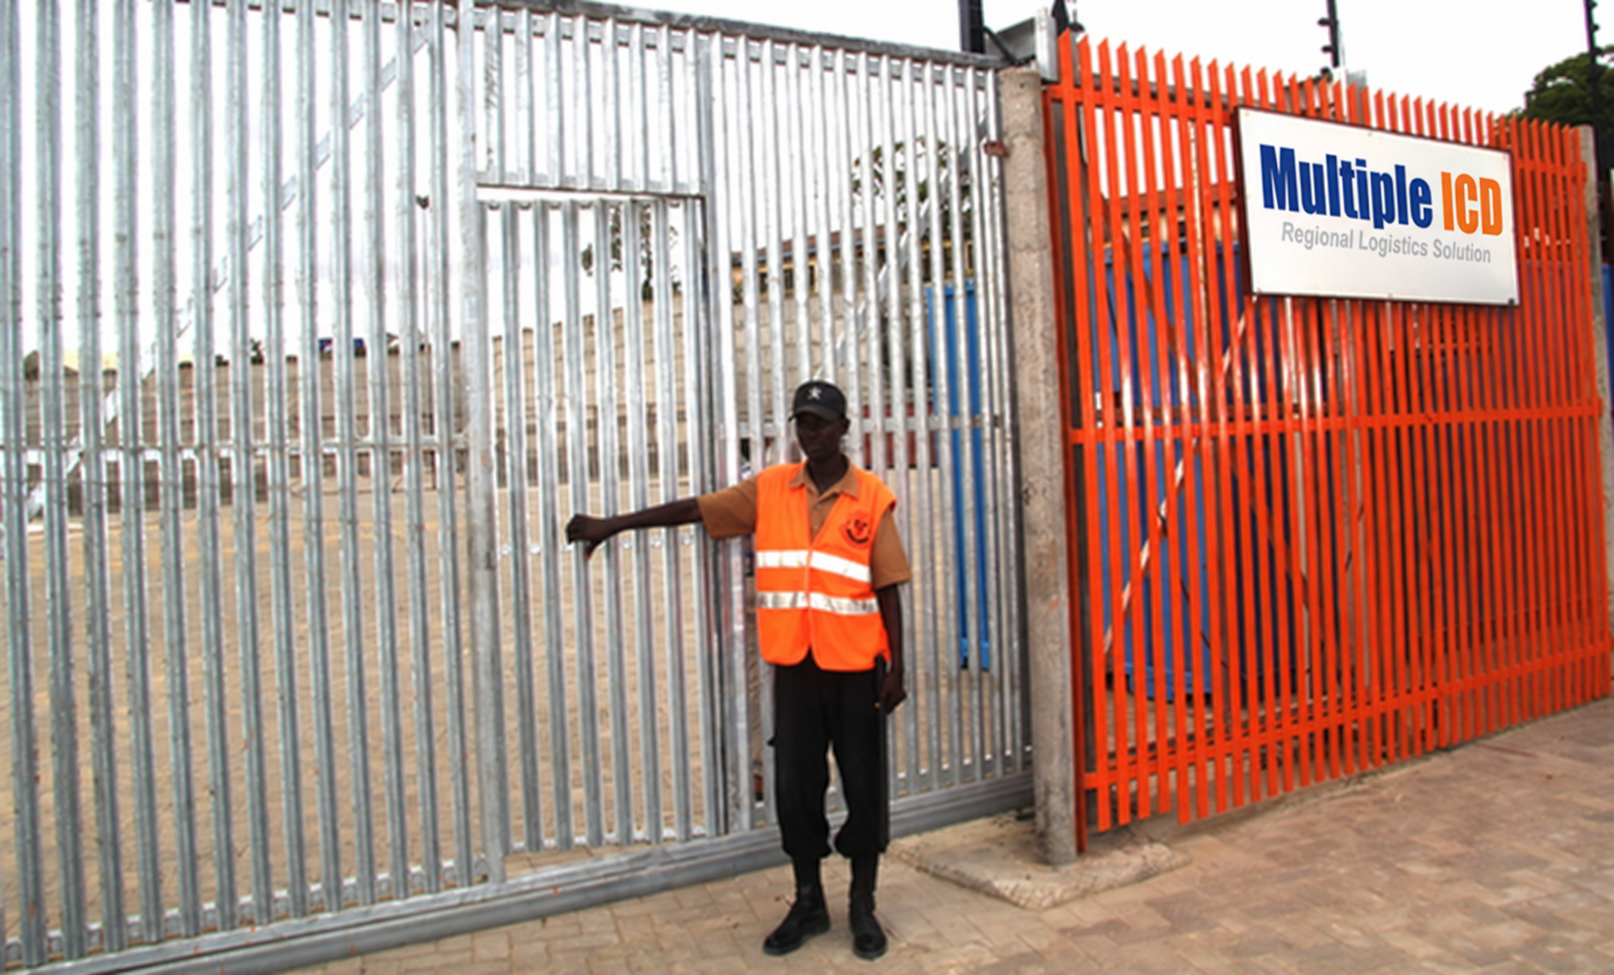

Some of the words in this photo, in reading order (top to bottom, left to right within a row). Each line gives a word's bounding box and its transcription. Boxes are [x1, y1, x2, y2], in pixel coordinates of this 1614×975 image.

[1259, 143, 1434, 230] Multiple
[1440, 171, 1503, 236] ICD
[1281, 221, 1353, 250] Regional
[1359, 230, 1428, 257] Logistics
[1432, 238, 1491, 263] Solution
